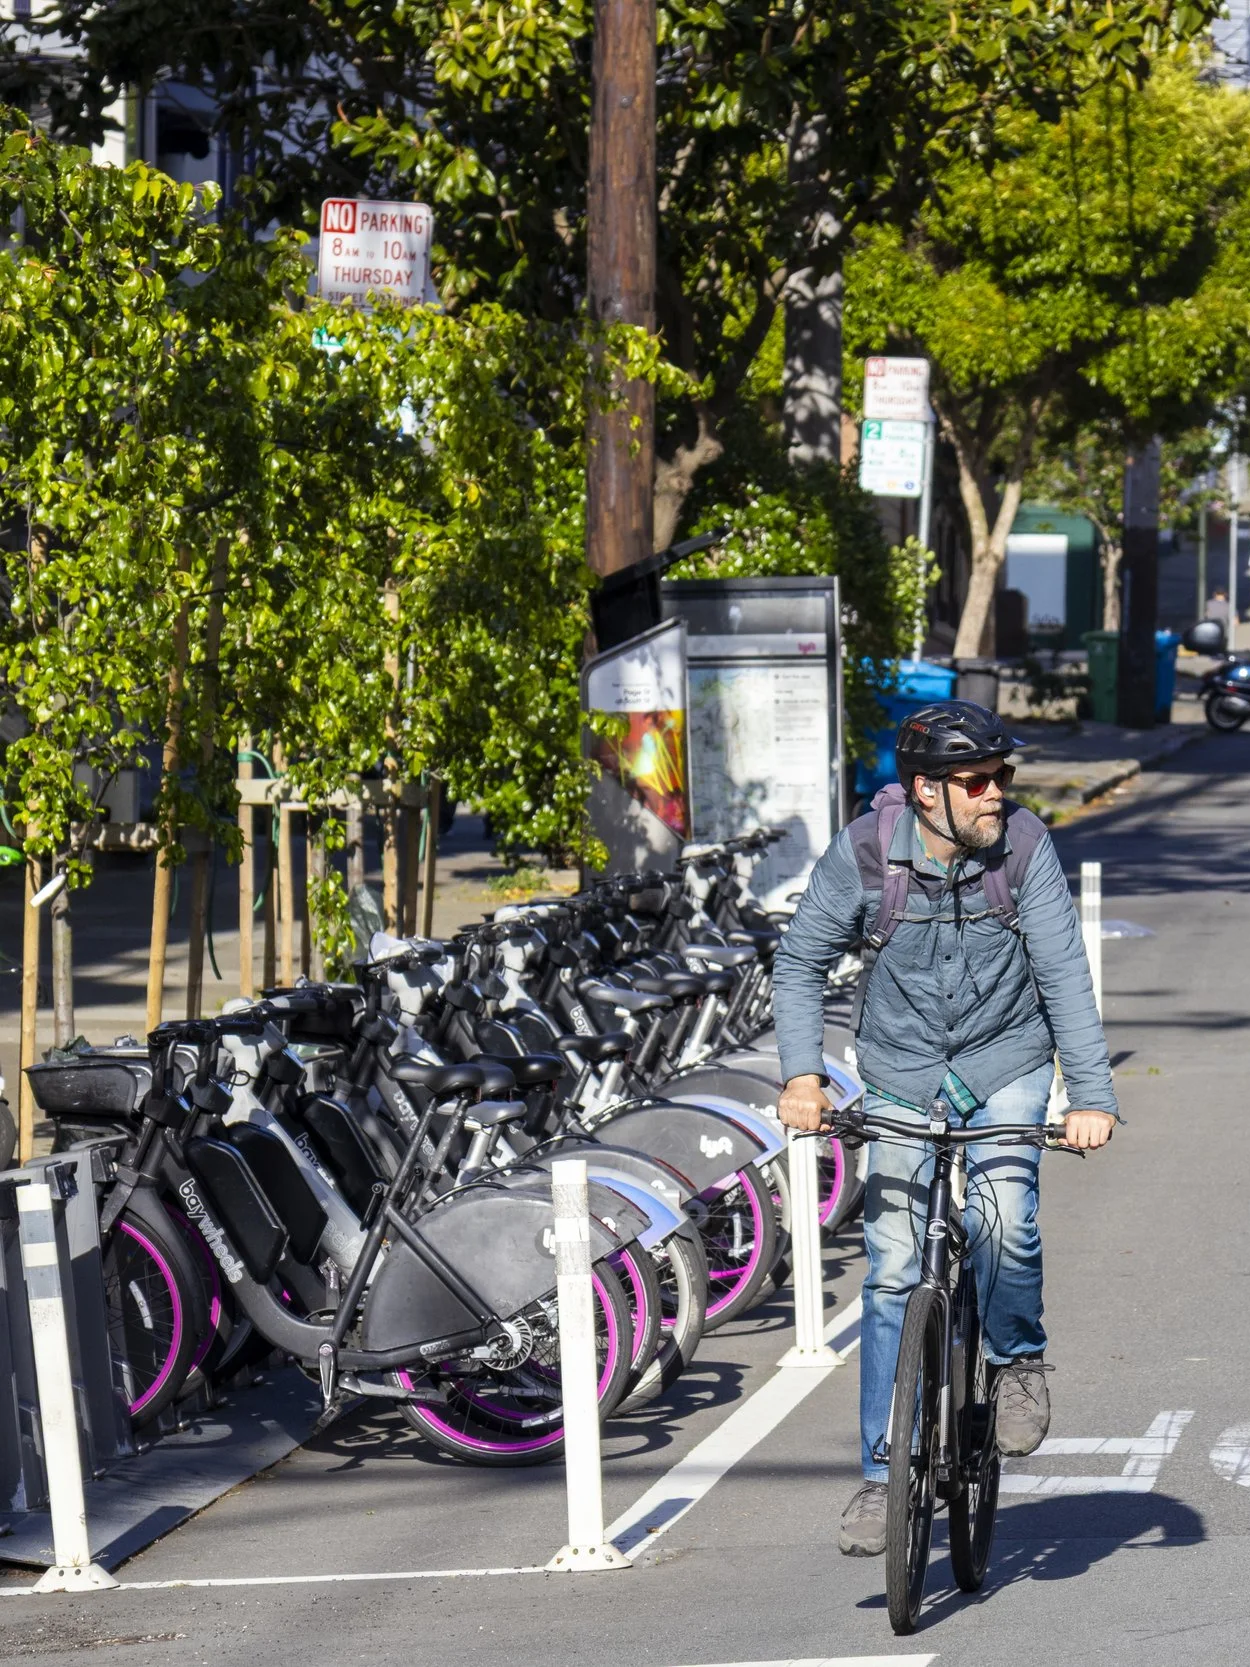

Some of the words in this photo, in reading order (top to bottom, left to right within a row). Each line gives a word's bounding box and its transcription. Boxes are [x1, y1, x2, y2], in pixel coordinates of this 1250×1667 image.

[326, 203, 353, 231] NO
[361, 212, 423, 235] PARKING
[333, 265, 414, 286] THURSDAY
[866, 422, 881, 439] 2
[700, 1132, 733, 1159] lyft
[179, 1177, 245, 1284] baywheels
